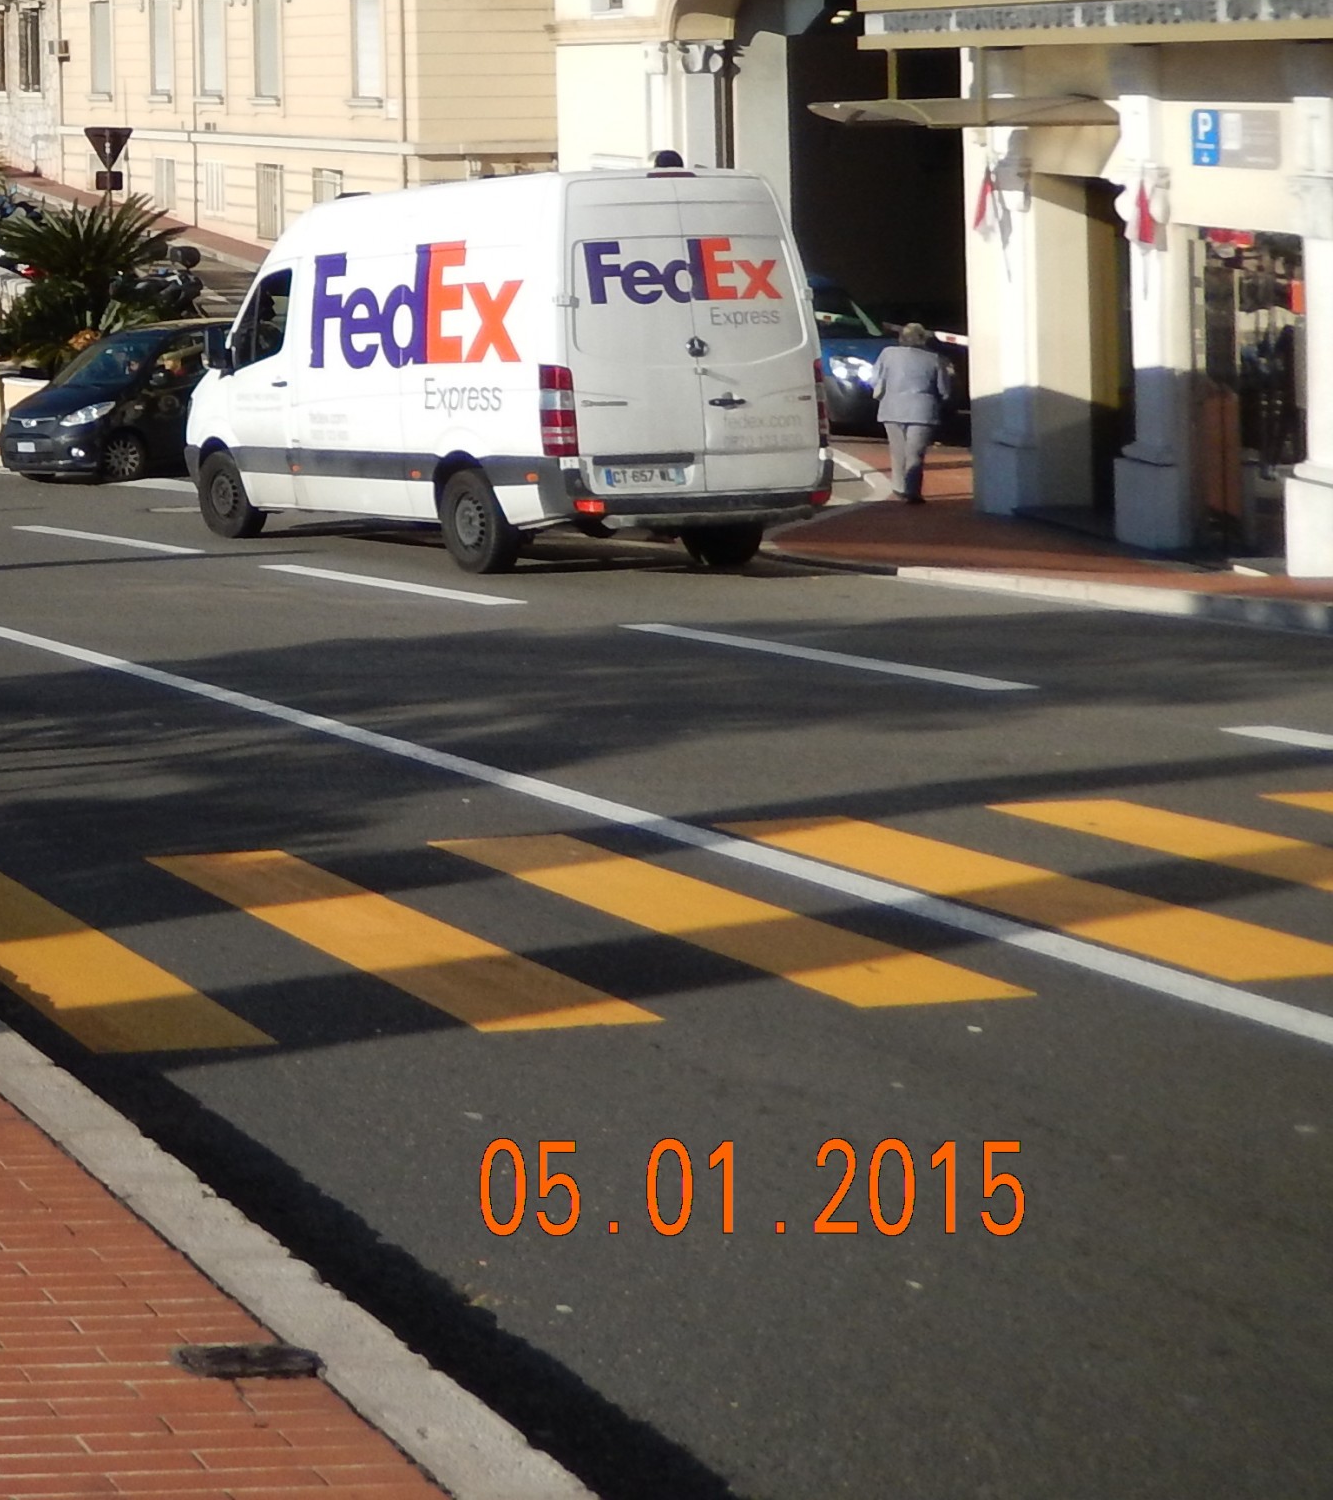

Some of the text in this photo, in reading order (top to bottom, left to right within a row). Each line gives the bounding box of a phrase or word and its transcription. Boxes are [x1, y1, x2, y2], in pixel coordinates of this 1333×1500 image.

[1198, 112, 1213, 140] P
[583, 237, 783, 305] FedEx
[309, 240, 524, 369] FedEx
[710, 306, 781, 329] Express
[424, 377, 503, 418] Express
